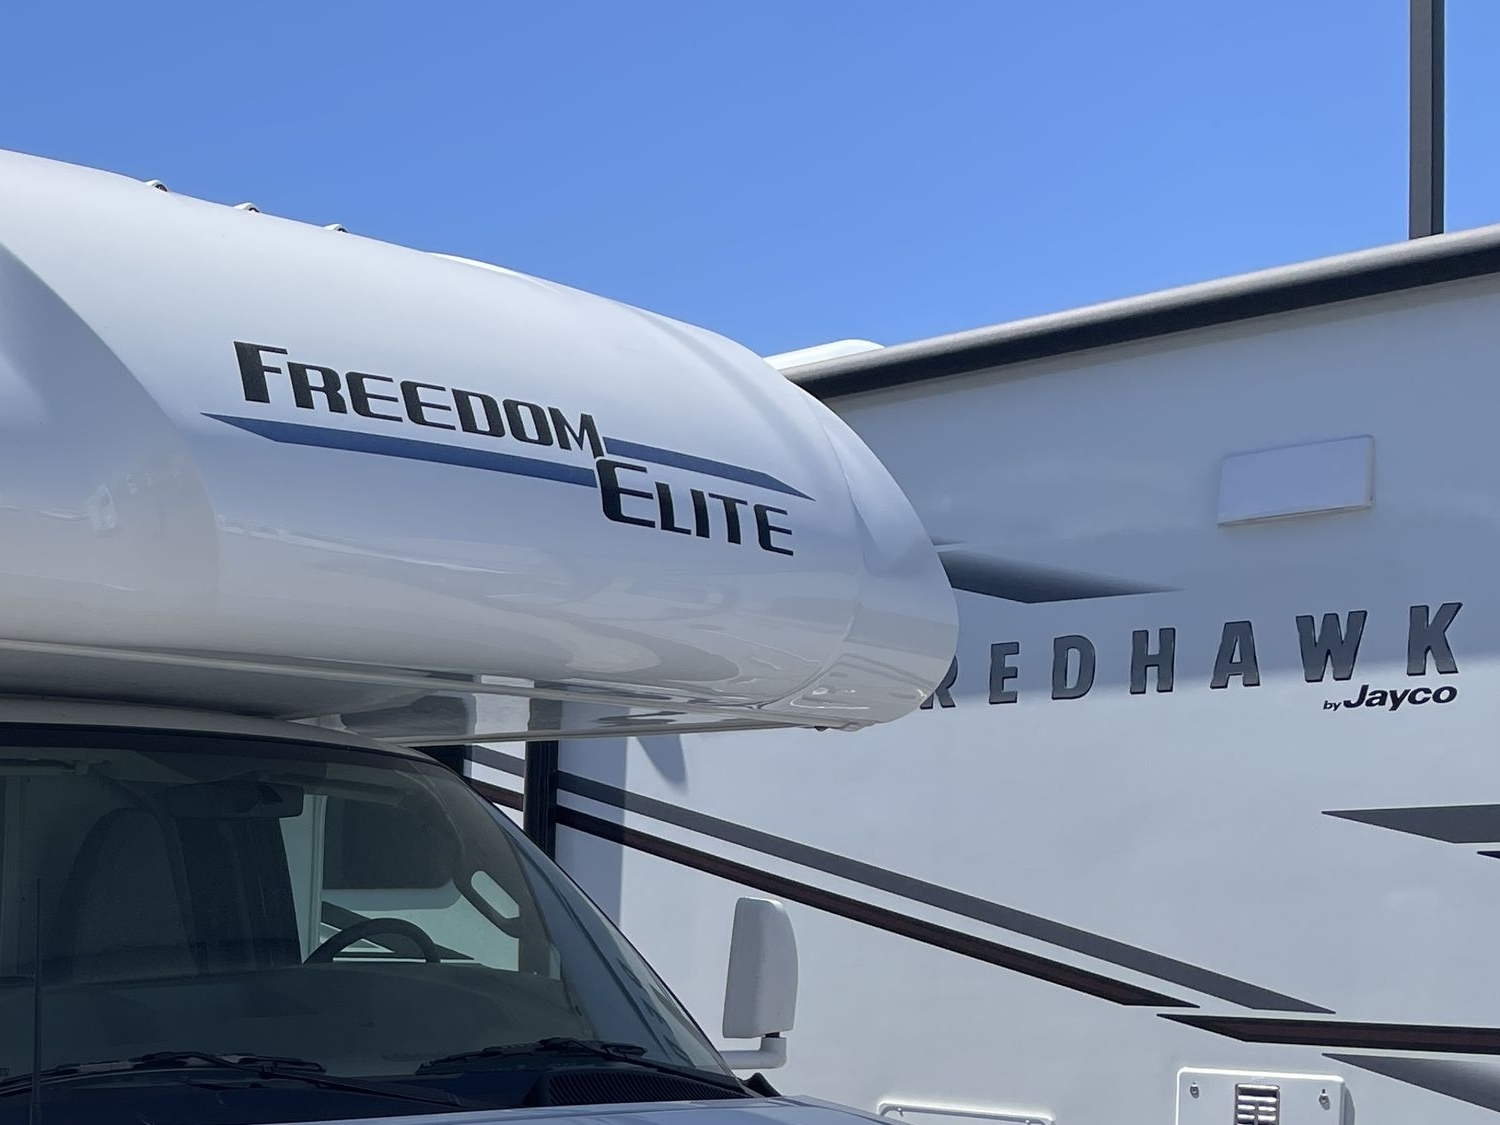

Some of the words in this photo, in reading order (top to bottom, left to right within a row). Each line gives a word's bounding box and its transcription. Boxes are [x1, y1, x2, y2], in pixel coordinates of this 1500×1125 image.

[233, 340, 605, 460] FREEDOM
[595, 456, 795, 557] ELITE
[1323, 700, 1342, 712] by
[1343, 684, 1458, 712] Jayco
